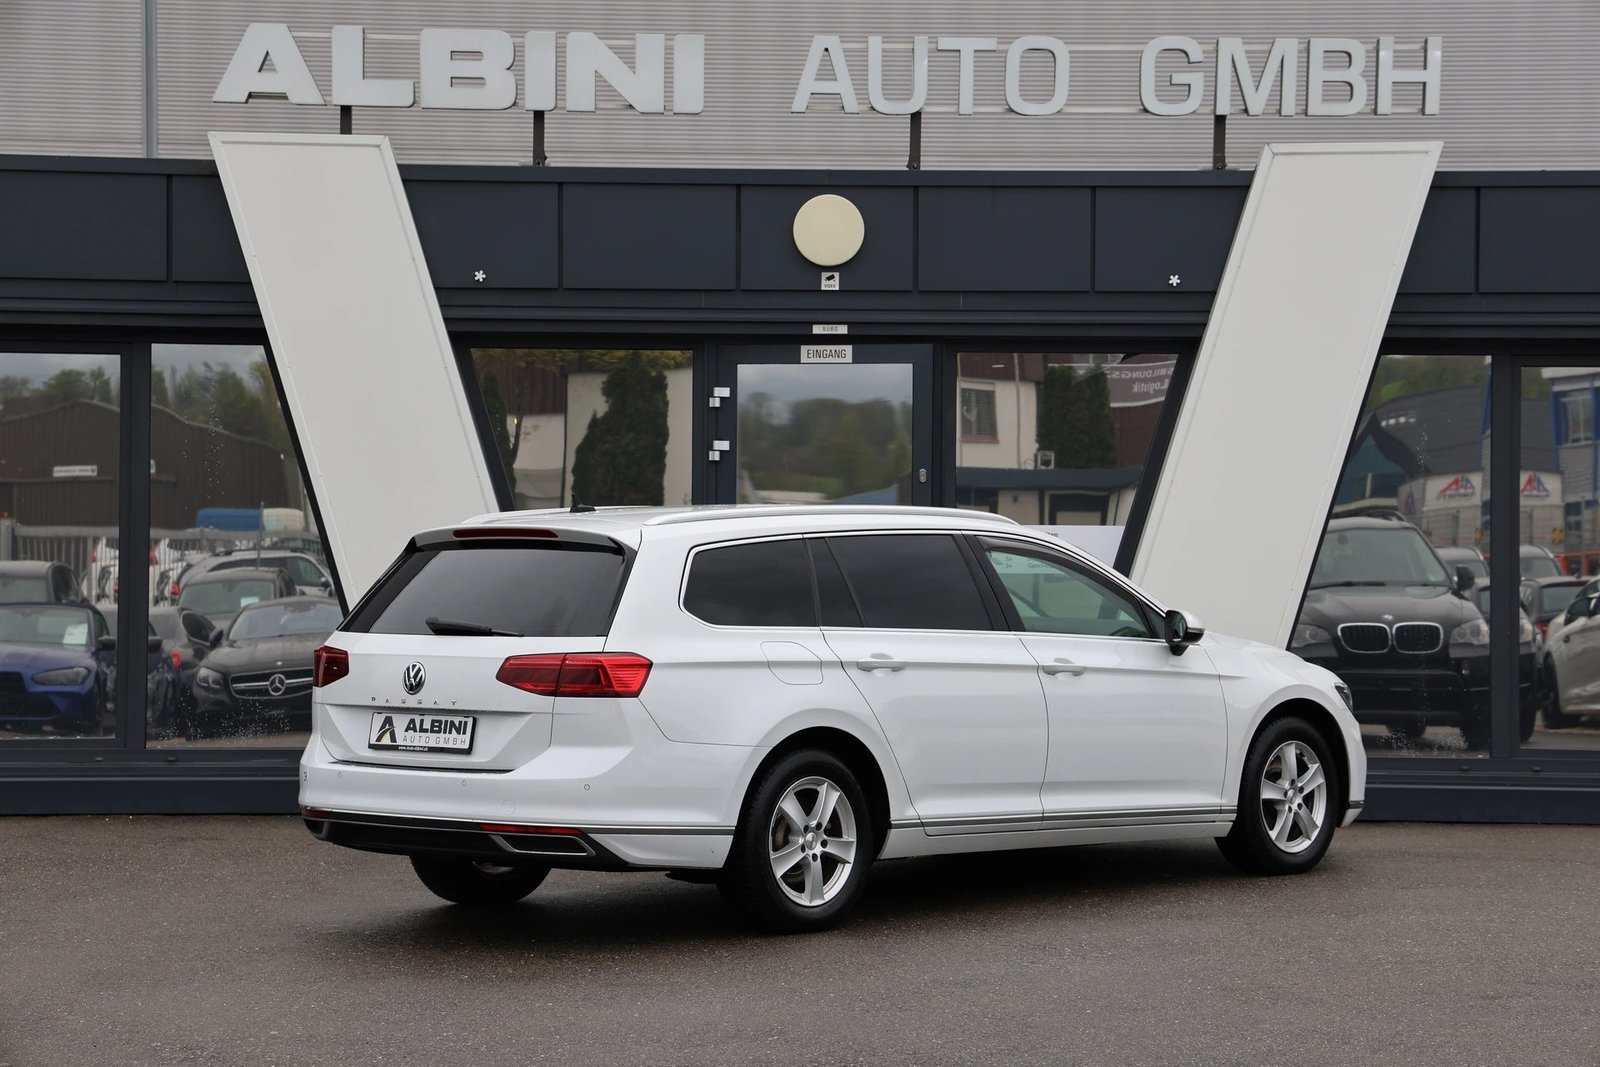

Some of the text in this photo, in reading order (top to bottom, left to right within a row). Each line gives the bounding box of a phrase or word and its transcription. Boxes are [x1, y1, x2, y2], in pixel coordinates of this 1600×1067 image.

[212, 23, 1443, 117] ALBINI AUTO GMBH
[806, 348, 847, 359] EINGANG
[404, 718, 469, 735] ALBINI
[402, 735, 466, 746] AUTO GMBH
